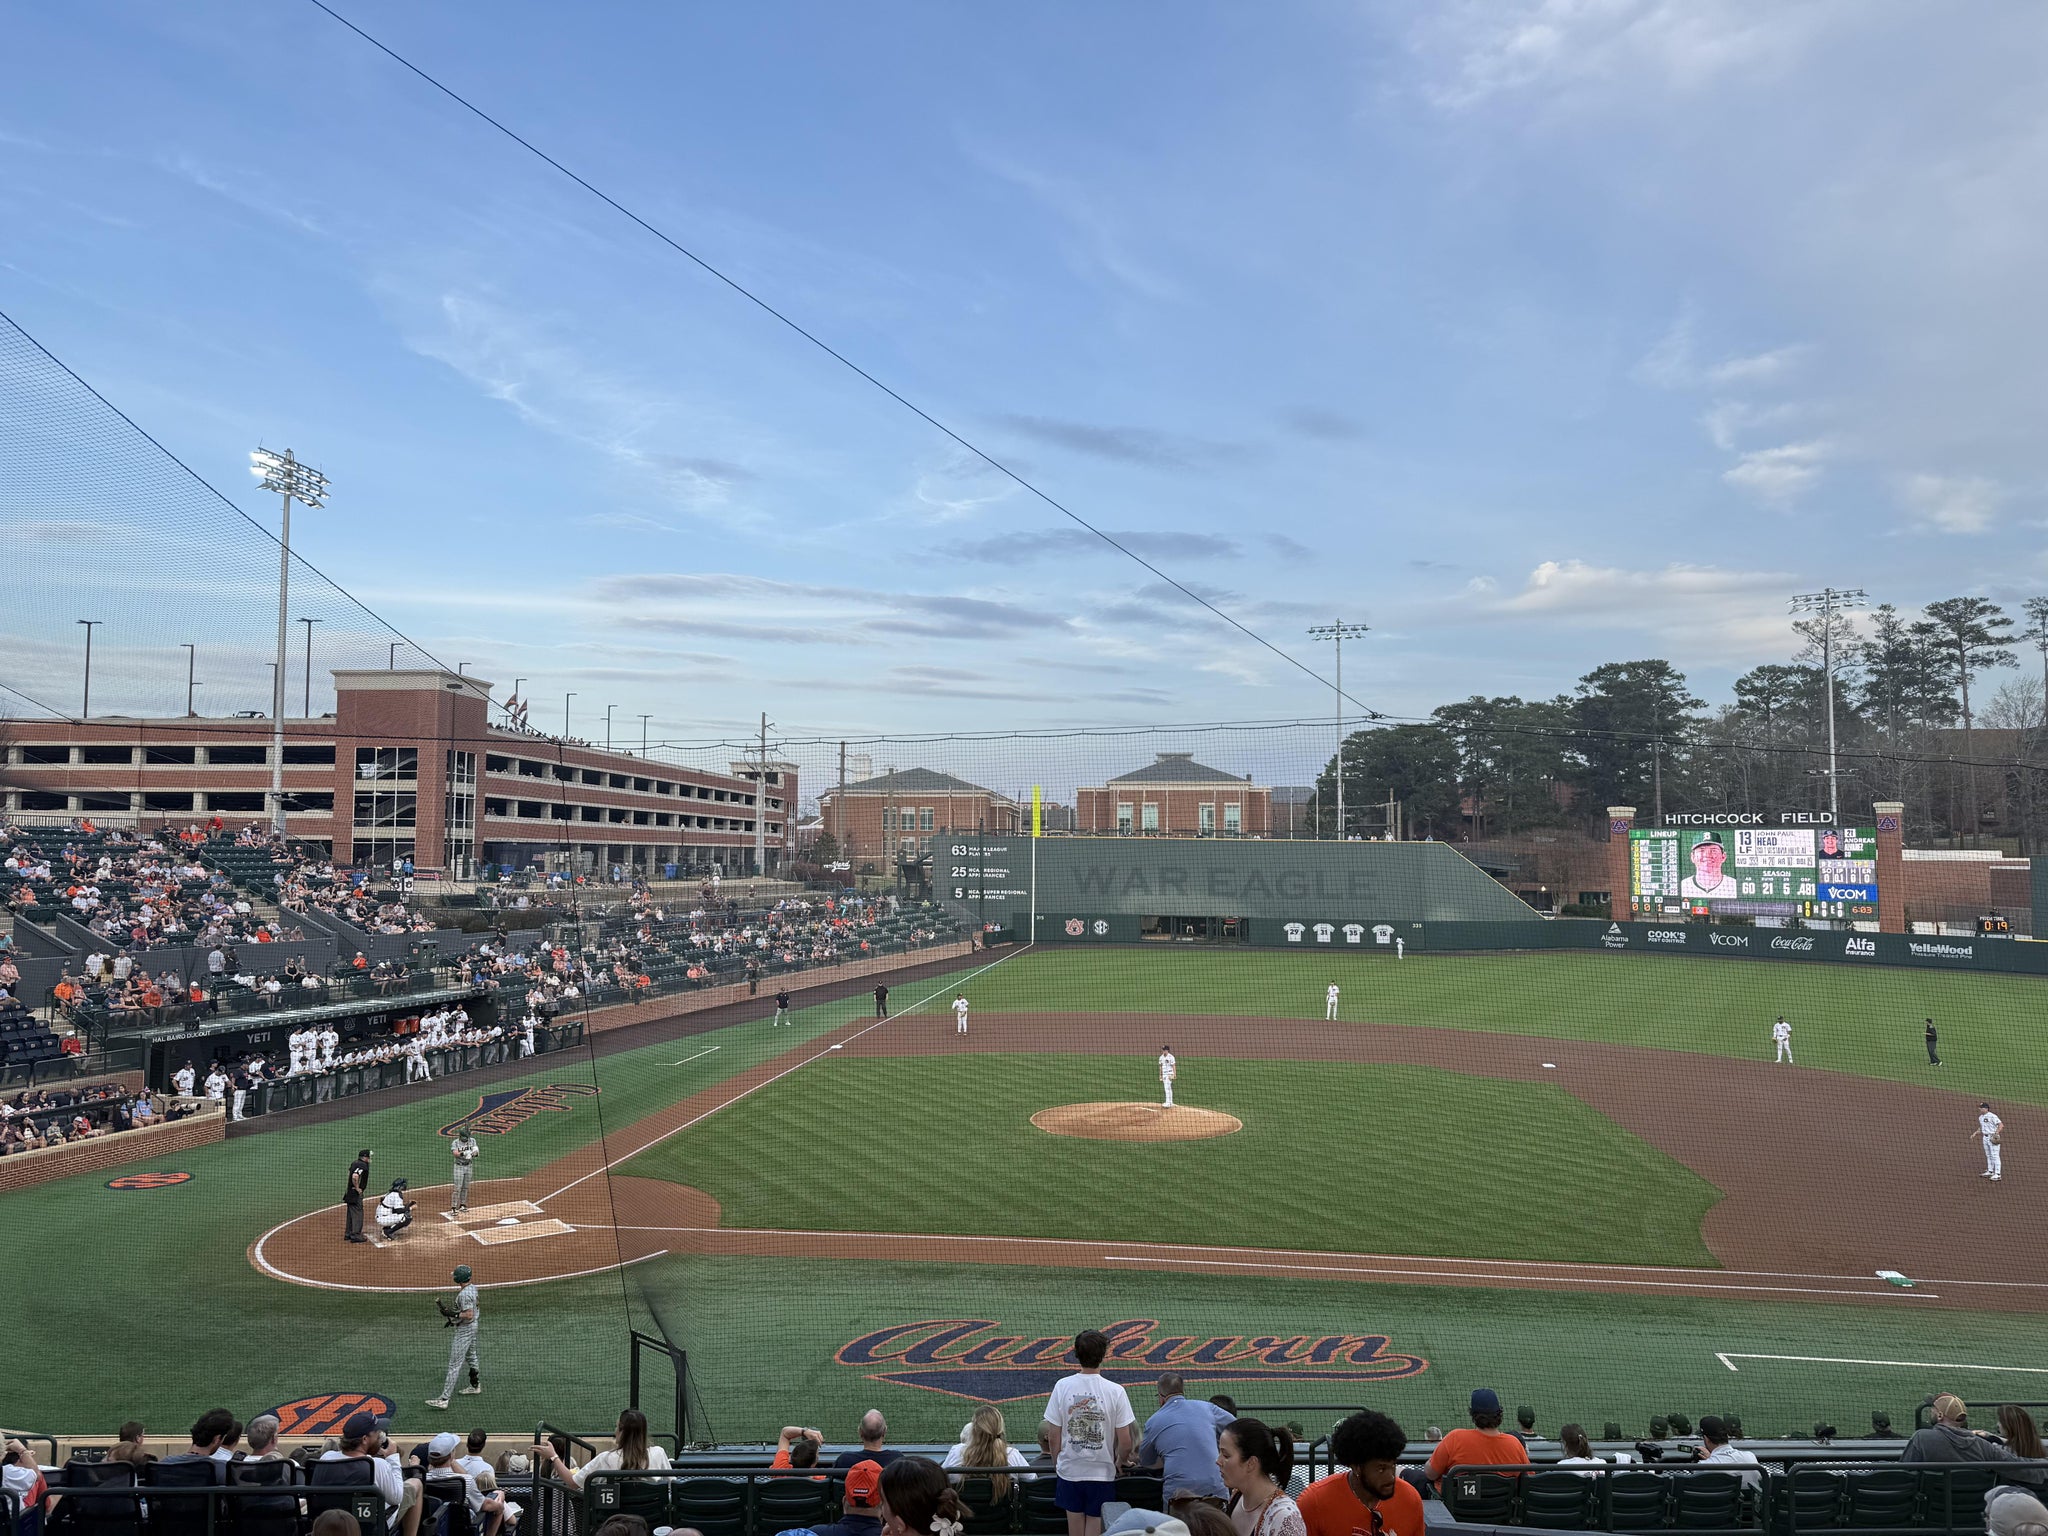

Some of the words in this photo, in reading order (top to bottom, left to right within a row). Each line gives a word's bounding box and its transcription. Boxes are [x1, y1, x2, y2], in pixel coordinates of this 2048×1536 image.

[1665, 813, 1764, 825] HITCHCOCK
[1781, 812, 1833, 823] FIELD
[1650, 830, 1678, 838] LINEUP
[1738, 831, 1752, 846] 13
[1756, 837, 1778, 846] HEAD
[951, 844, 967, 856] 63
[1739, 846, 1753, 854] LF
[951, 866, 967, 877] 25
[1073, 865, 1188, 897] WAR
[1208, 866, 1380, 900] EAGLE
[1823, 873, 1830, 883] 0
[1850, 873, 1857, 883] 0
[1863, 874, 1870, 884] 0
[954, 887, 963, 898] 5
[1742, 882, 1756, 895] 60
[1762, 882, 1774, 895] 21
[1782, 883, 1791, 895] 5
[1796, 883, 1816, 896] .481
[1827, 886, 1867, 900] VCOM
[1093, 919, 1109, 935] SEC
[1984, 920, 2008, 931] 0:19
[1600, 934, 1629, 942] Alabama
[1647, 930, 1686, 939] COOK'S
[1709, 932, 1749, 947] VCOM
[1845, 937, 1875, 951] Alfa
[1908, 943, 1973, 955] YellaWood
[367, 1015, 387, 1025] YETI
[166, 1033, 186, 1042] BAIRD
[186, 1030, 212, 1039] DUGOUT
[247, 1031, 271, 1044] YETI
[833, 1319, 1429, 1384] Auburn
[1463, 1484, 1477, 1496] 14
[600, 1492, 614, 1504] 15
[357, 1506, 371, 1518] 16
